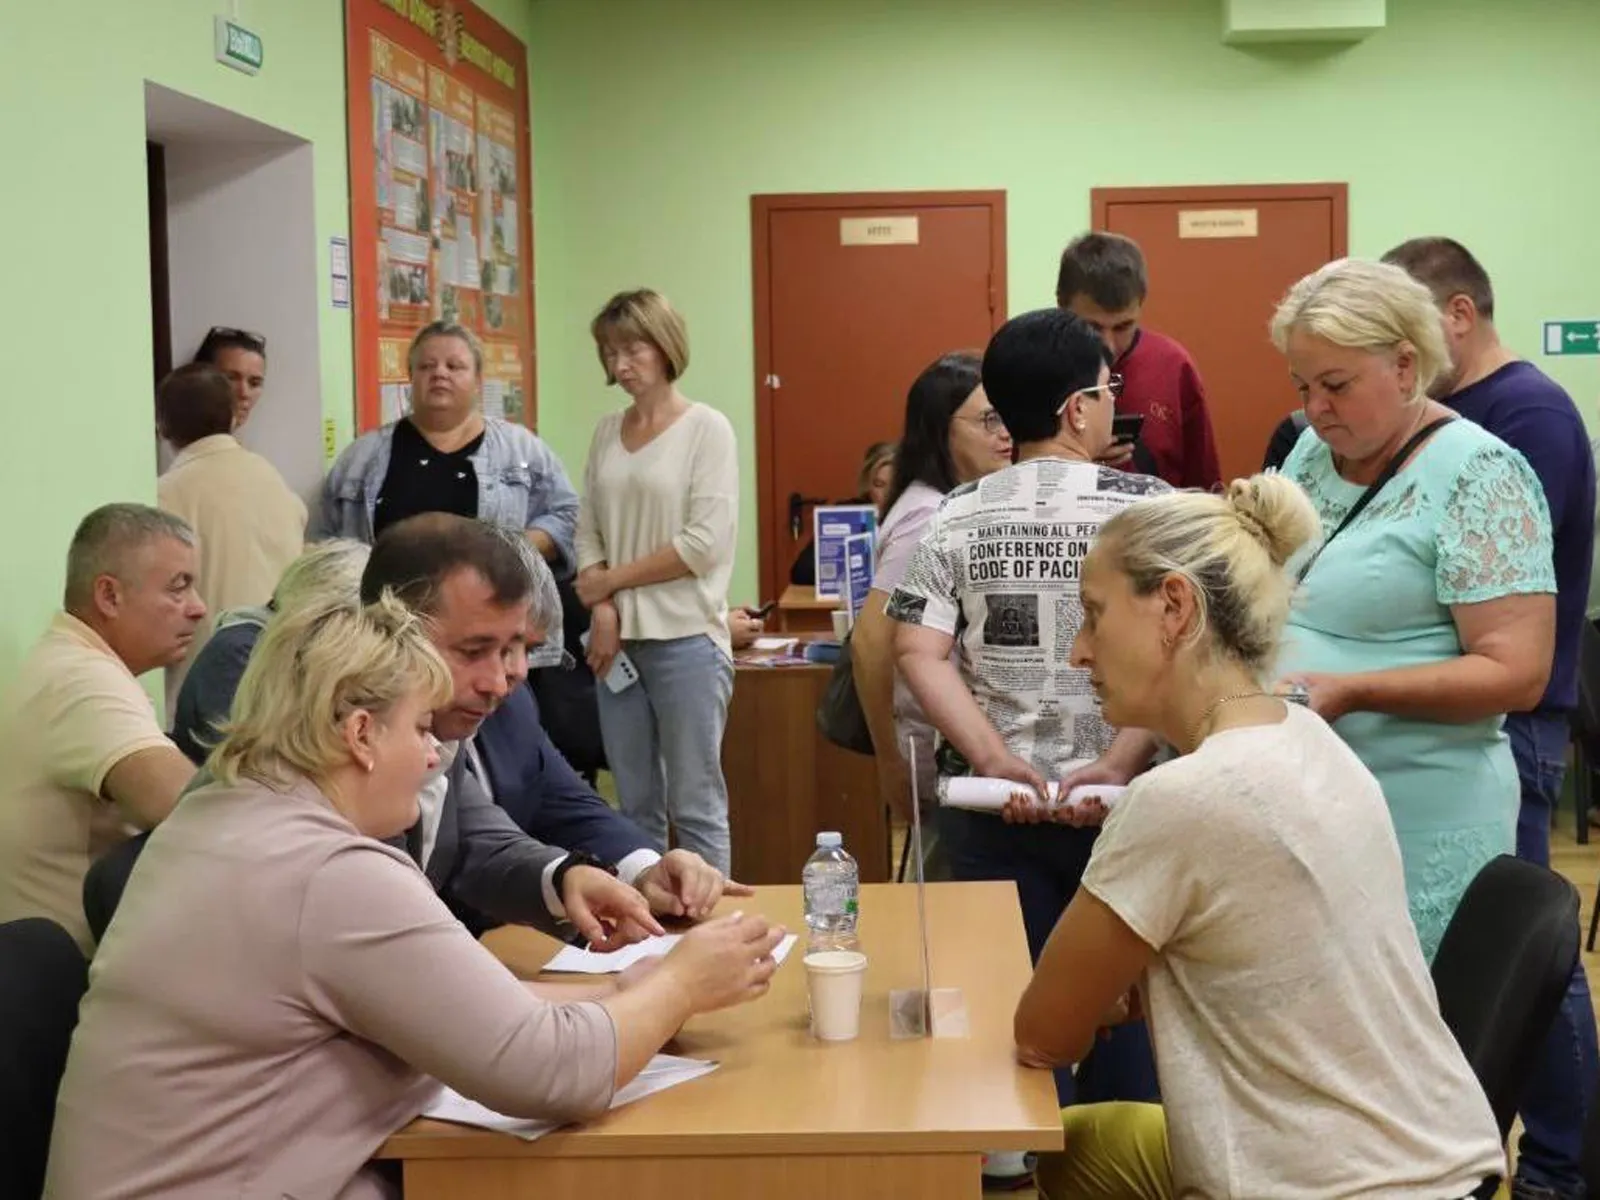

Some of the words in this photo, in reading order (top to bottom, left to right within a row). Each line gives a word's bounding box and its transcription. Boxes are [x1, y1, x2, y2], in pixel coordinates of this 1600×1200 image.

[978, 524, 1049, 539] MAINTAINING
[1050, 525, 1070, 537] ALL
[969, 541, 1064, 560] CONFERENCE
[1067, 541, 1088, 557] ON
[969, 560, 1009, 581] CODE
[1013, 560, 1035, 578] OF
[1039, 561, 1082, 579] PACI
